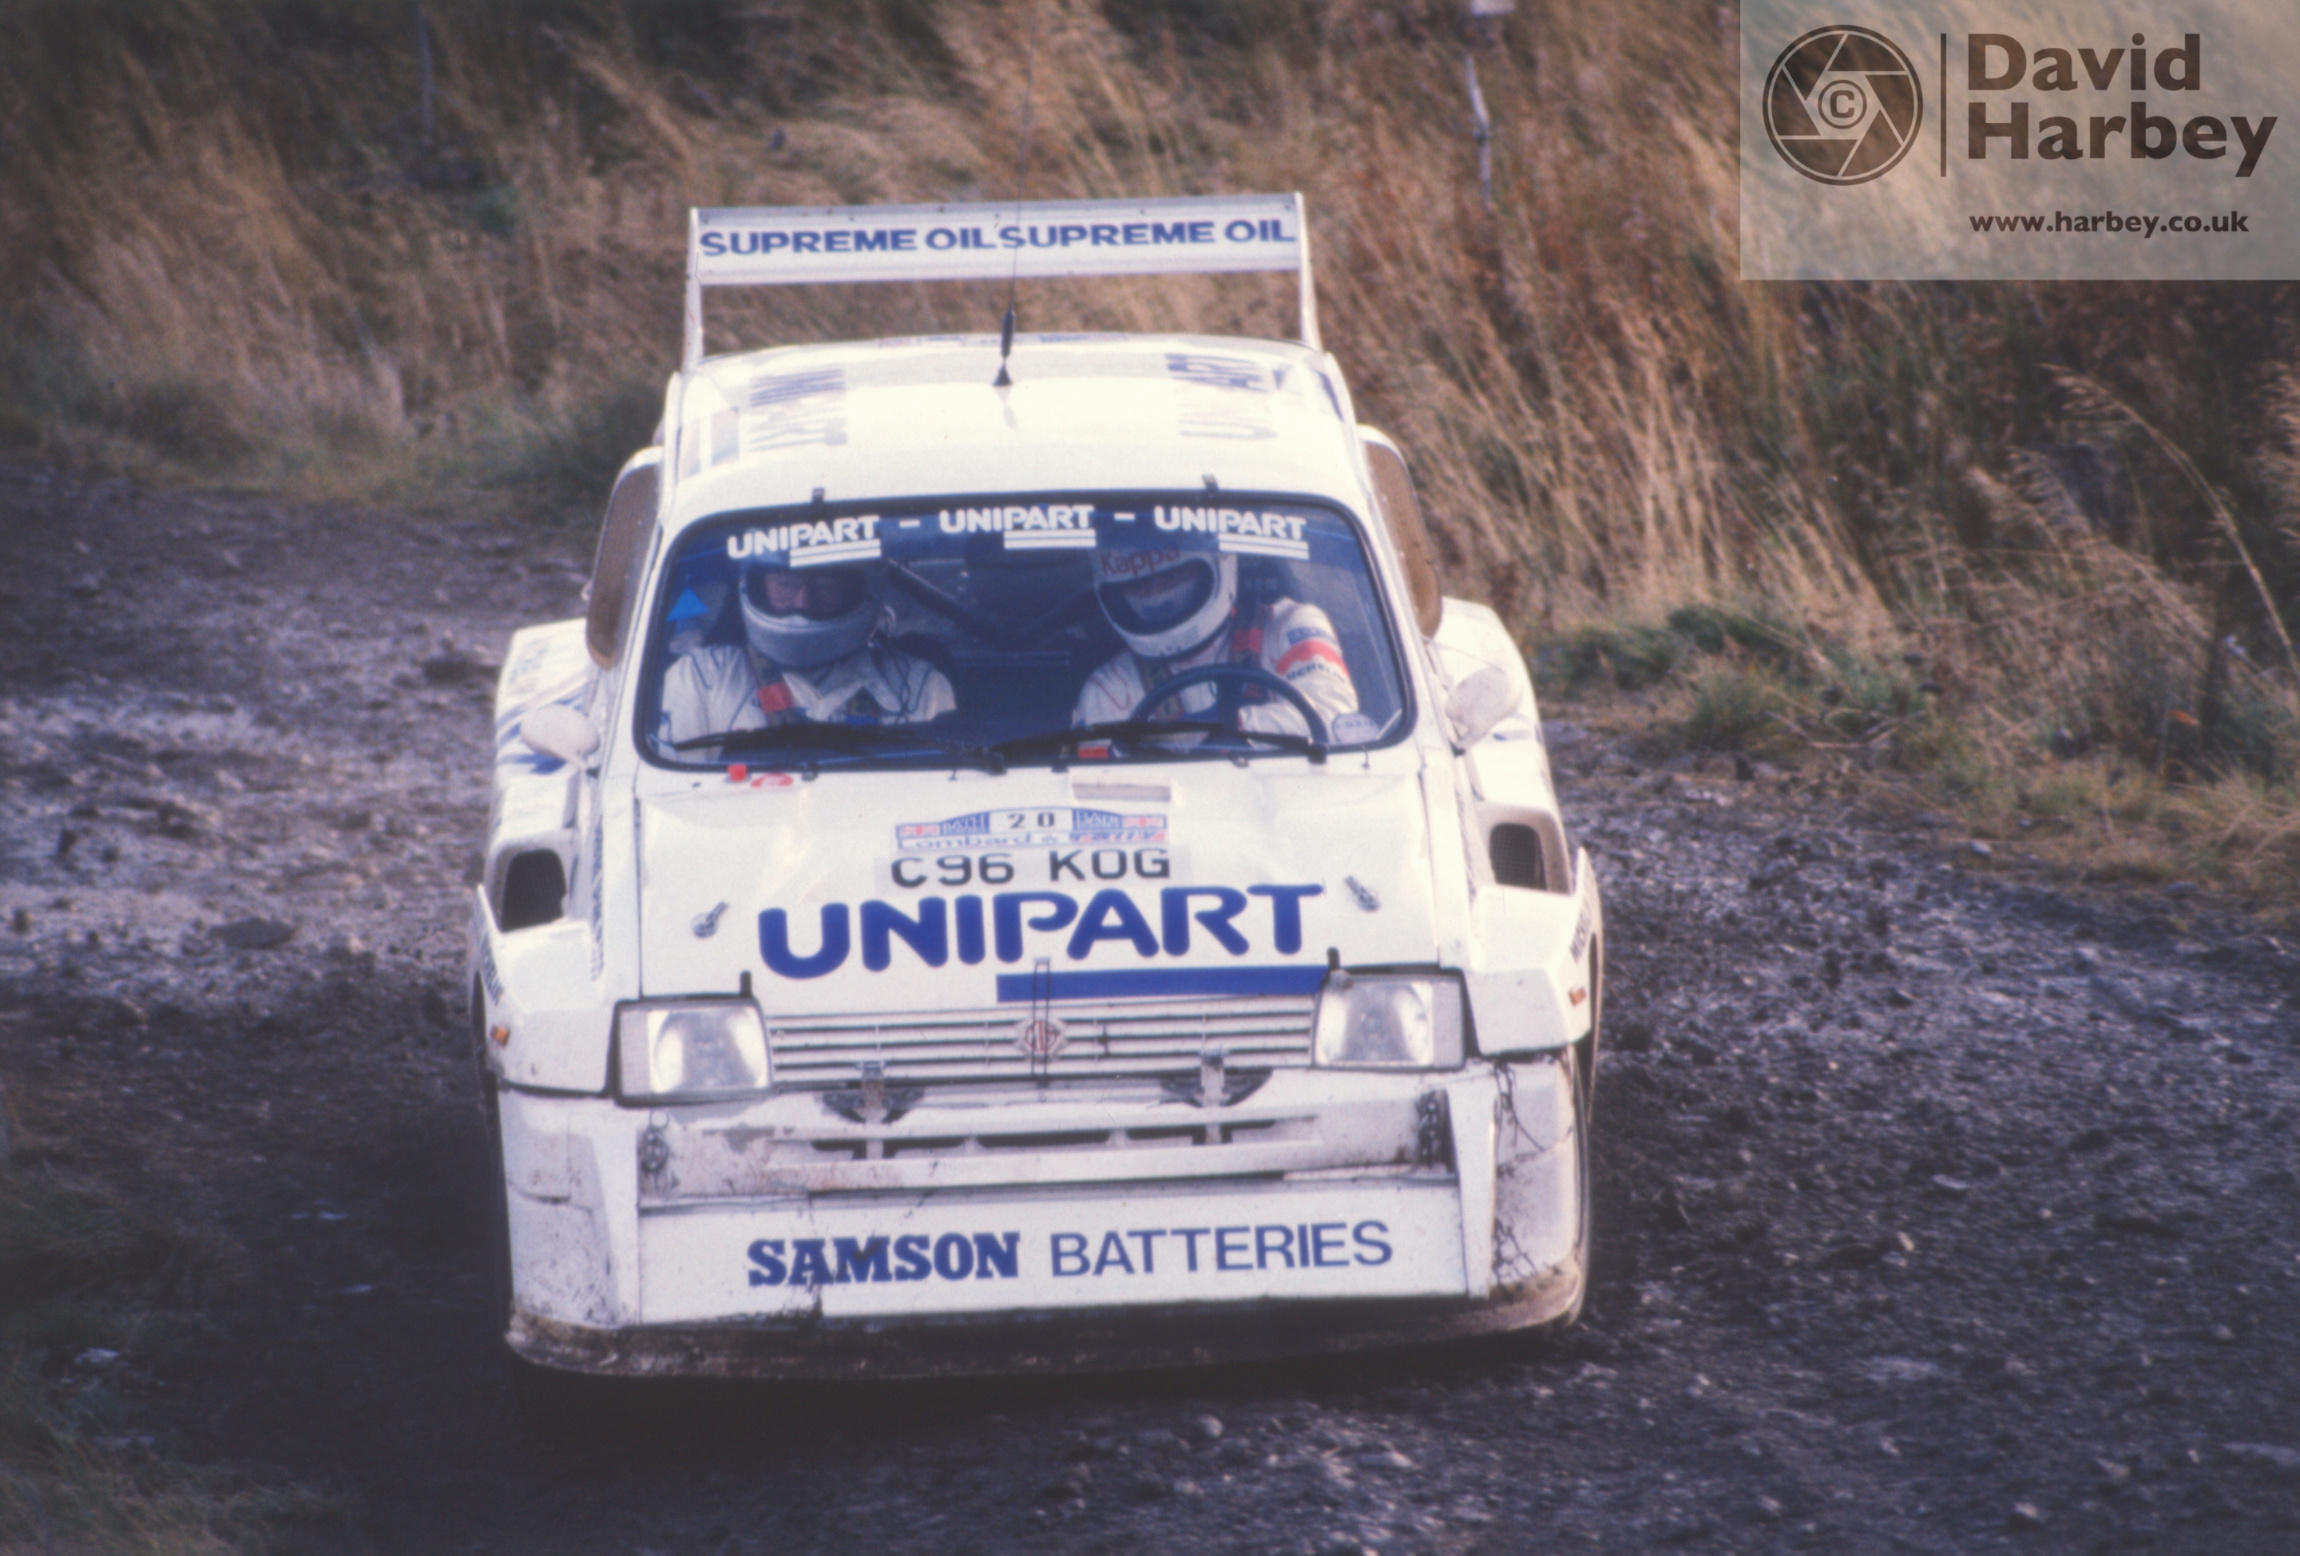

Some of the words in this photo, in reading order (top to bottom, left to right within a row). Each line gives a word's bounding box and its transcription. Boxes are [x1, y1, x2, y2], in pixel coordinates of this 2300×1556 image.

[700, 229, 917, 256] SUPREME
[925, 227, 997, 251] OIL
[999, 221, 1216, 249] SUPREME
[1225, 219, 1296, 243] OIL
[728, 515, 879, 559] UNIPART
[939, 505, 1094, 534] UNIPART
[1154, 506, 1306, 541] UNIPART
[1100, 543, 1180, 577] Kappa
[1008, 811, 1055, 830] 20
[901, 833, 1030, 848] Lombard
[891, 853, 1014, 888] C96
[1050, 848, 1170, 882] KOG
[758, 884, 1324, 979] UNIPART
[747, 1232, 1020, 1287] SAMSON
[1050, 1219, 1394, 1278] BATTERIES
